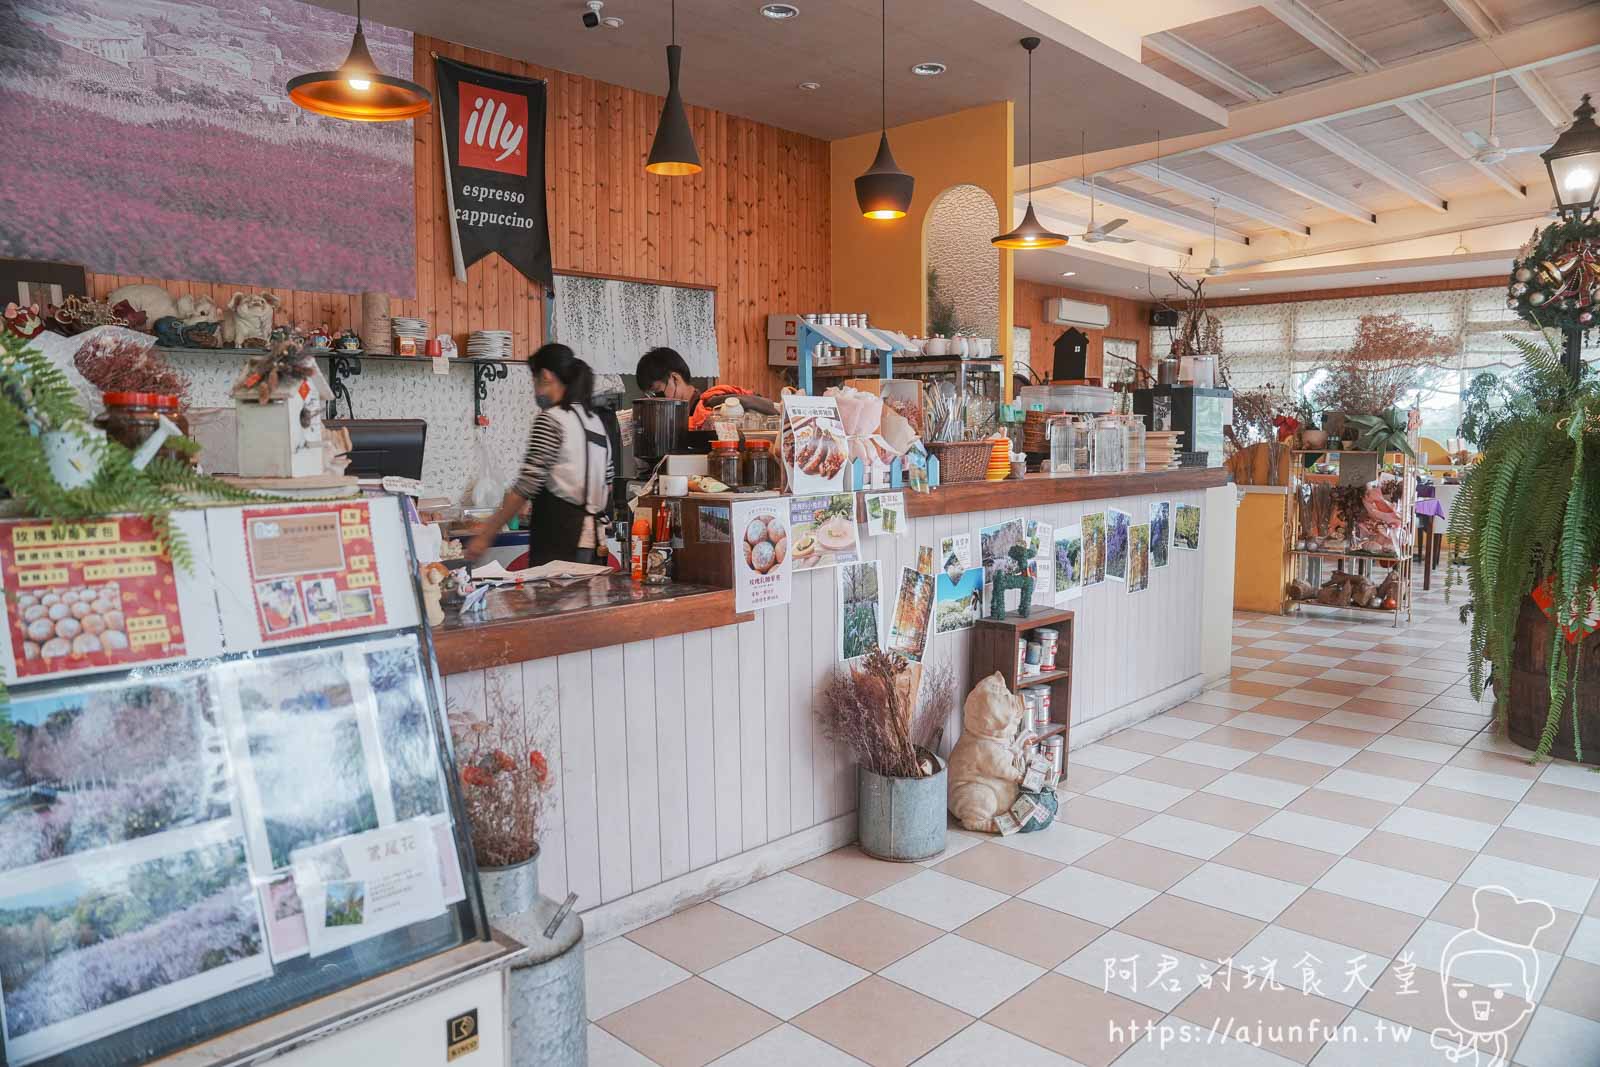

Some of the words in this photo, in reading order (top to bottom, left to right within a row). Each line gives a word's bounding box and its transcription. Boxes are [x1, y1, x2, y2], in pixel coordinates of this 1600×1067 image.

[464, 97, 524, 162] illy
[463, 183, 525, 204] espresso
[455, 207, 534, 230] cappuccino
